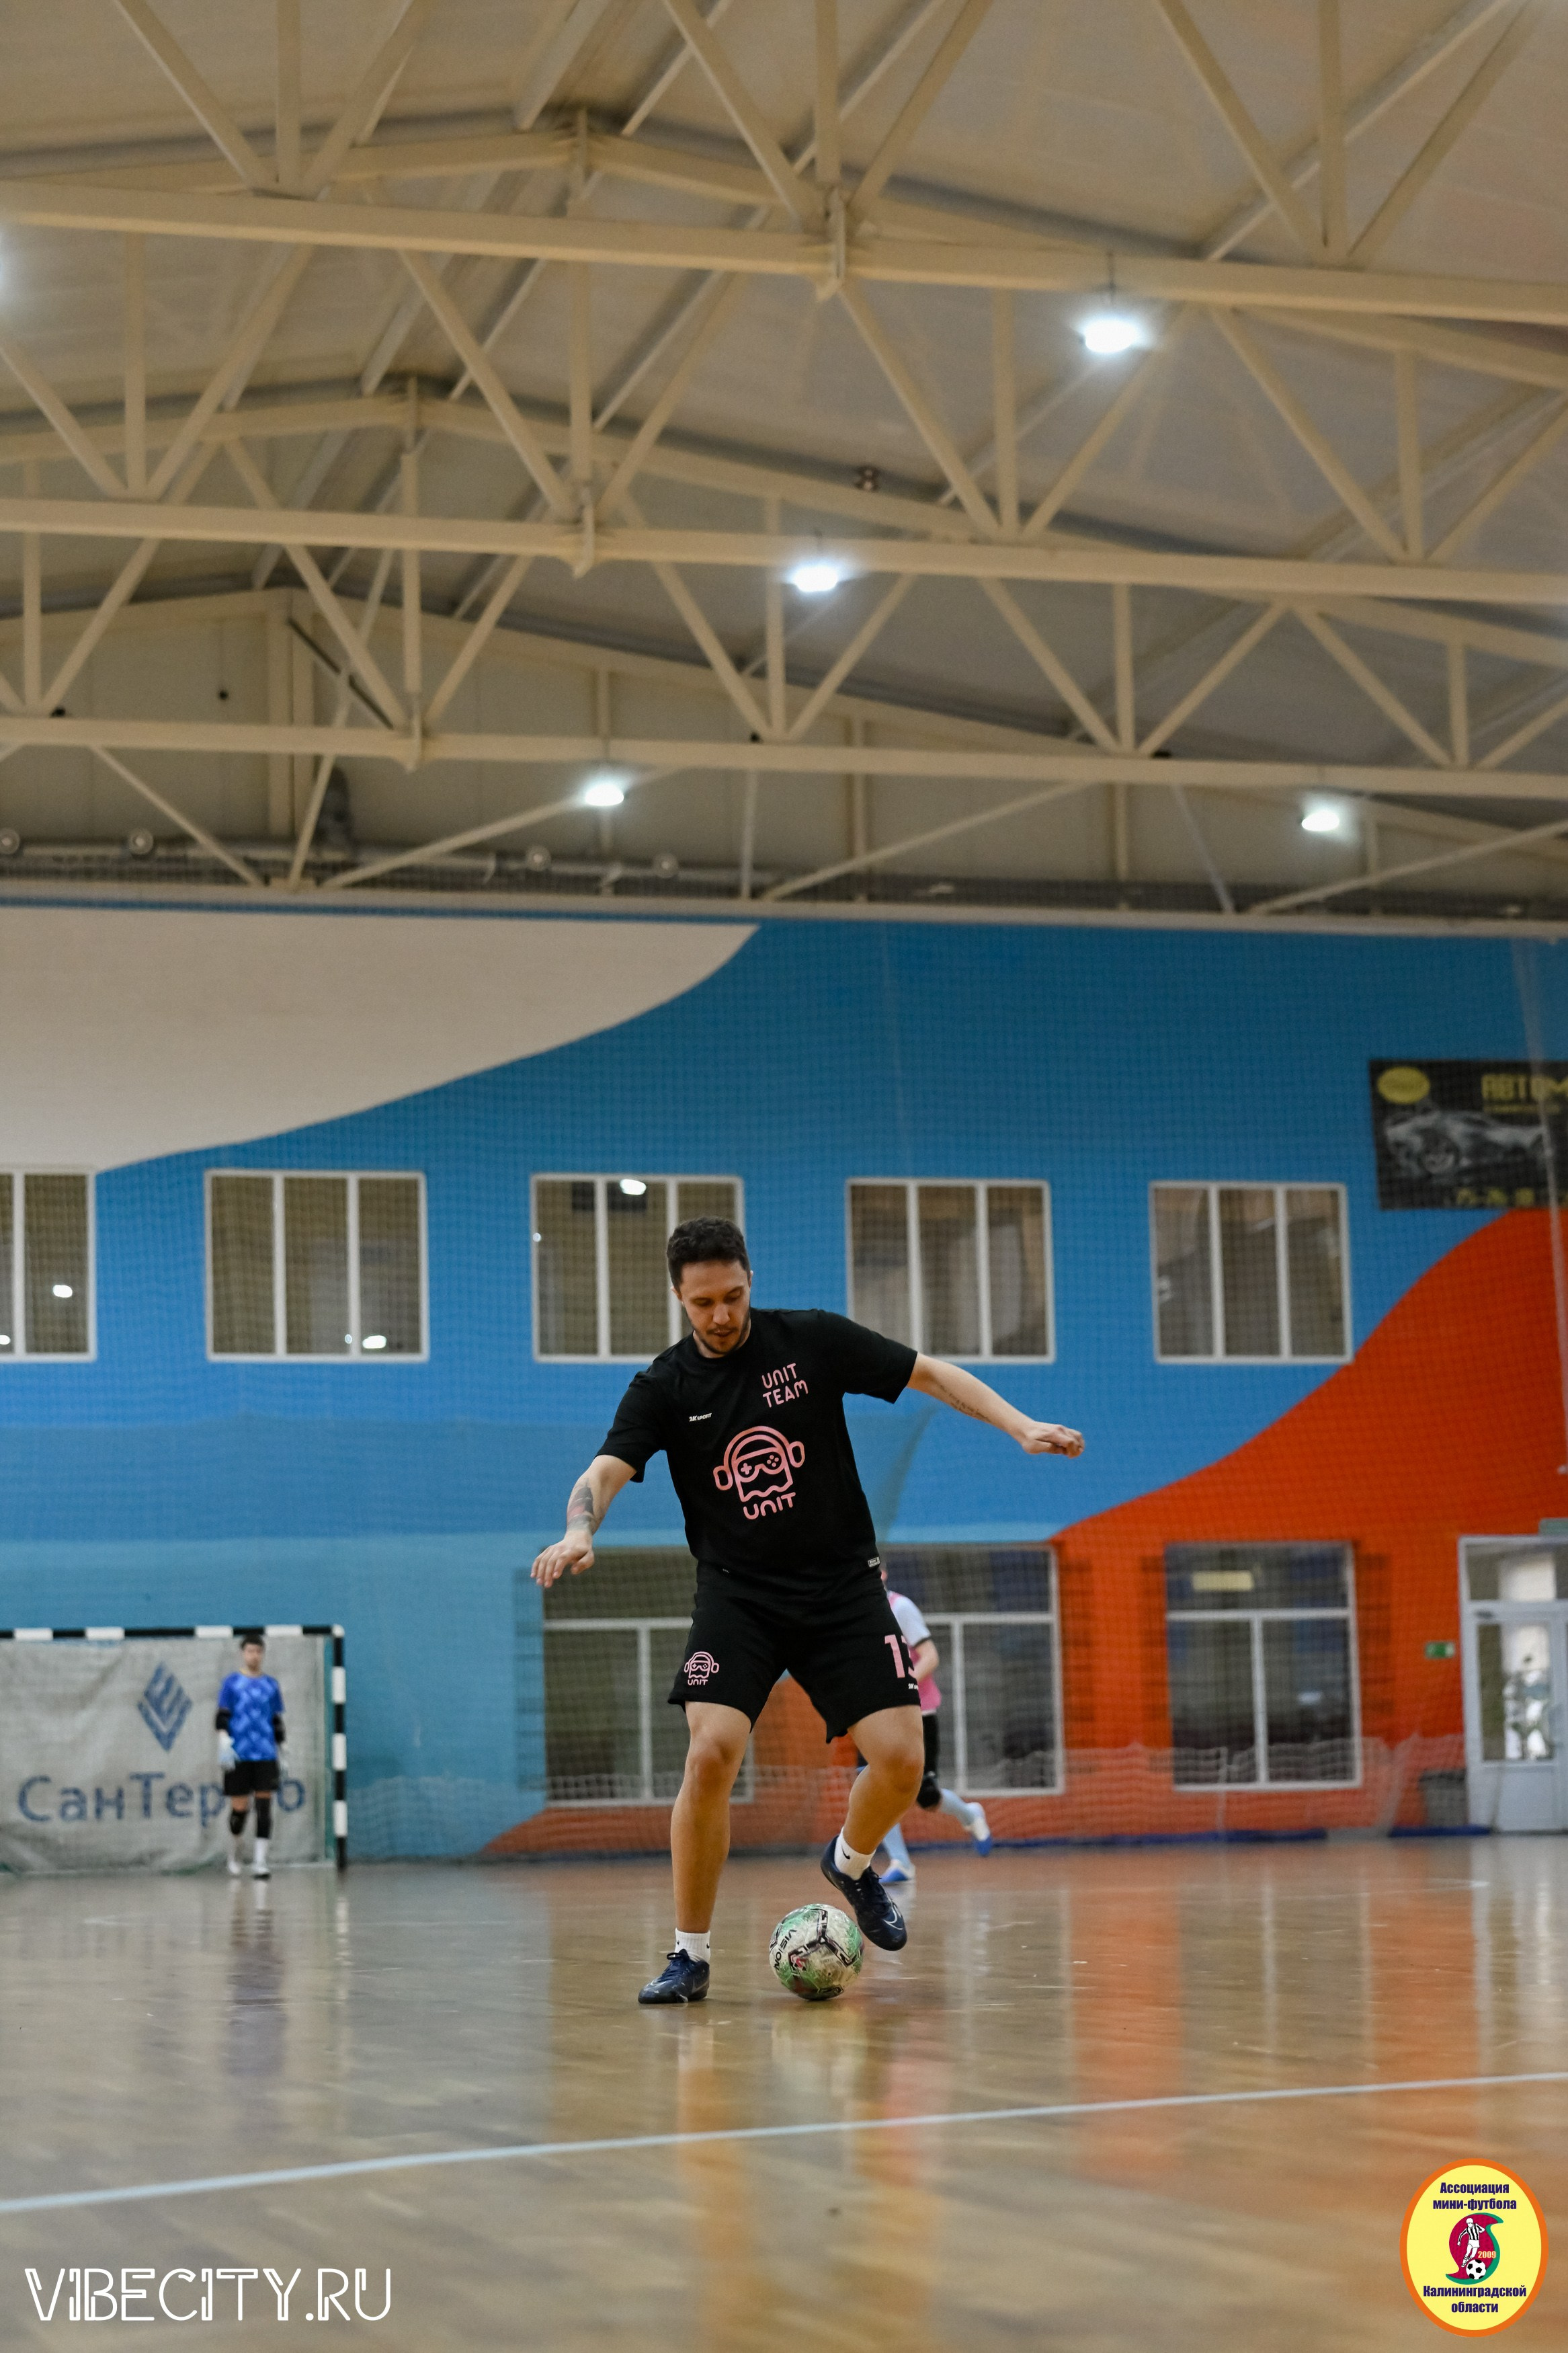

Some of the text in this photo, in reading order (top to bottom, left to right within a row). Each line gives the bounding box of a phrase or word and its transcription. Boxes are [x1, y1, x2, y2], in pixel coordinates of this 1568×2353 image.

[761, 1363, 796, 1389] UNIT
[763, 1380, 809, 1408] TEAM
[743, 1492, 796, 1520] UNIT
[17, 1771, 306, 1827] СанТеро
[773, 1929, 797, 1970] VISION
